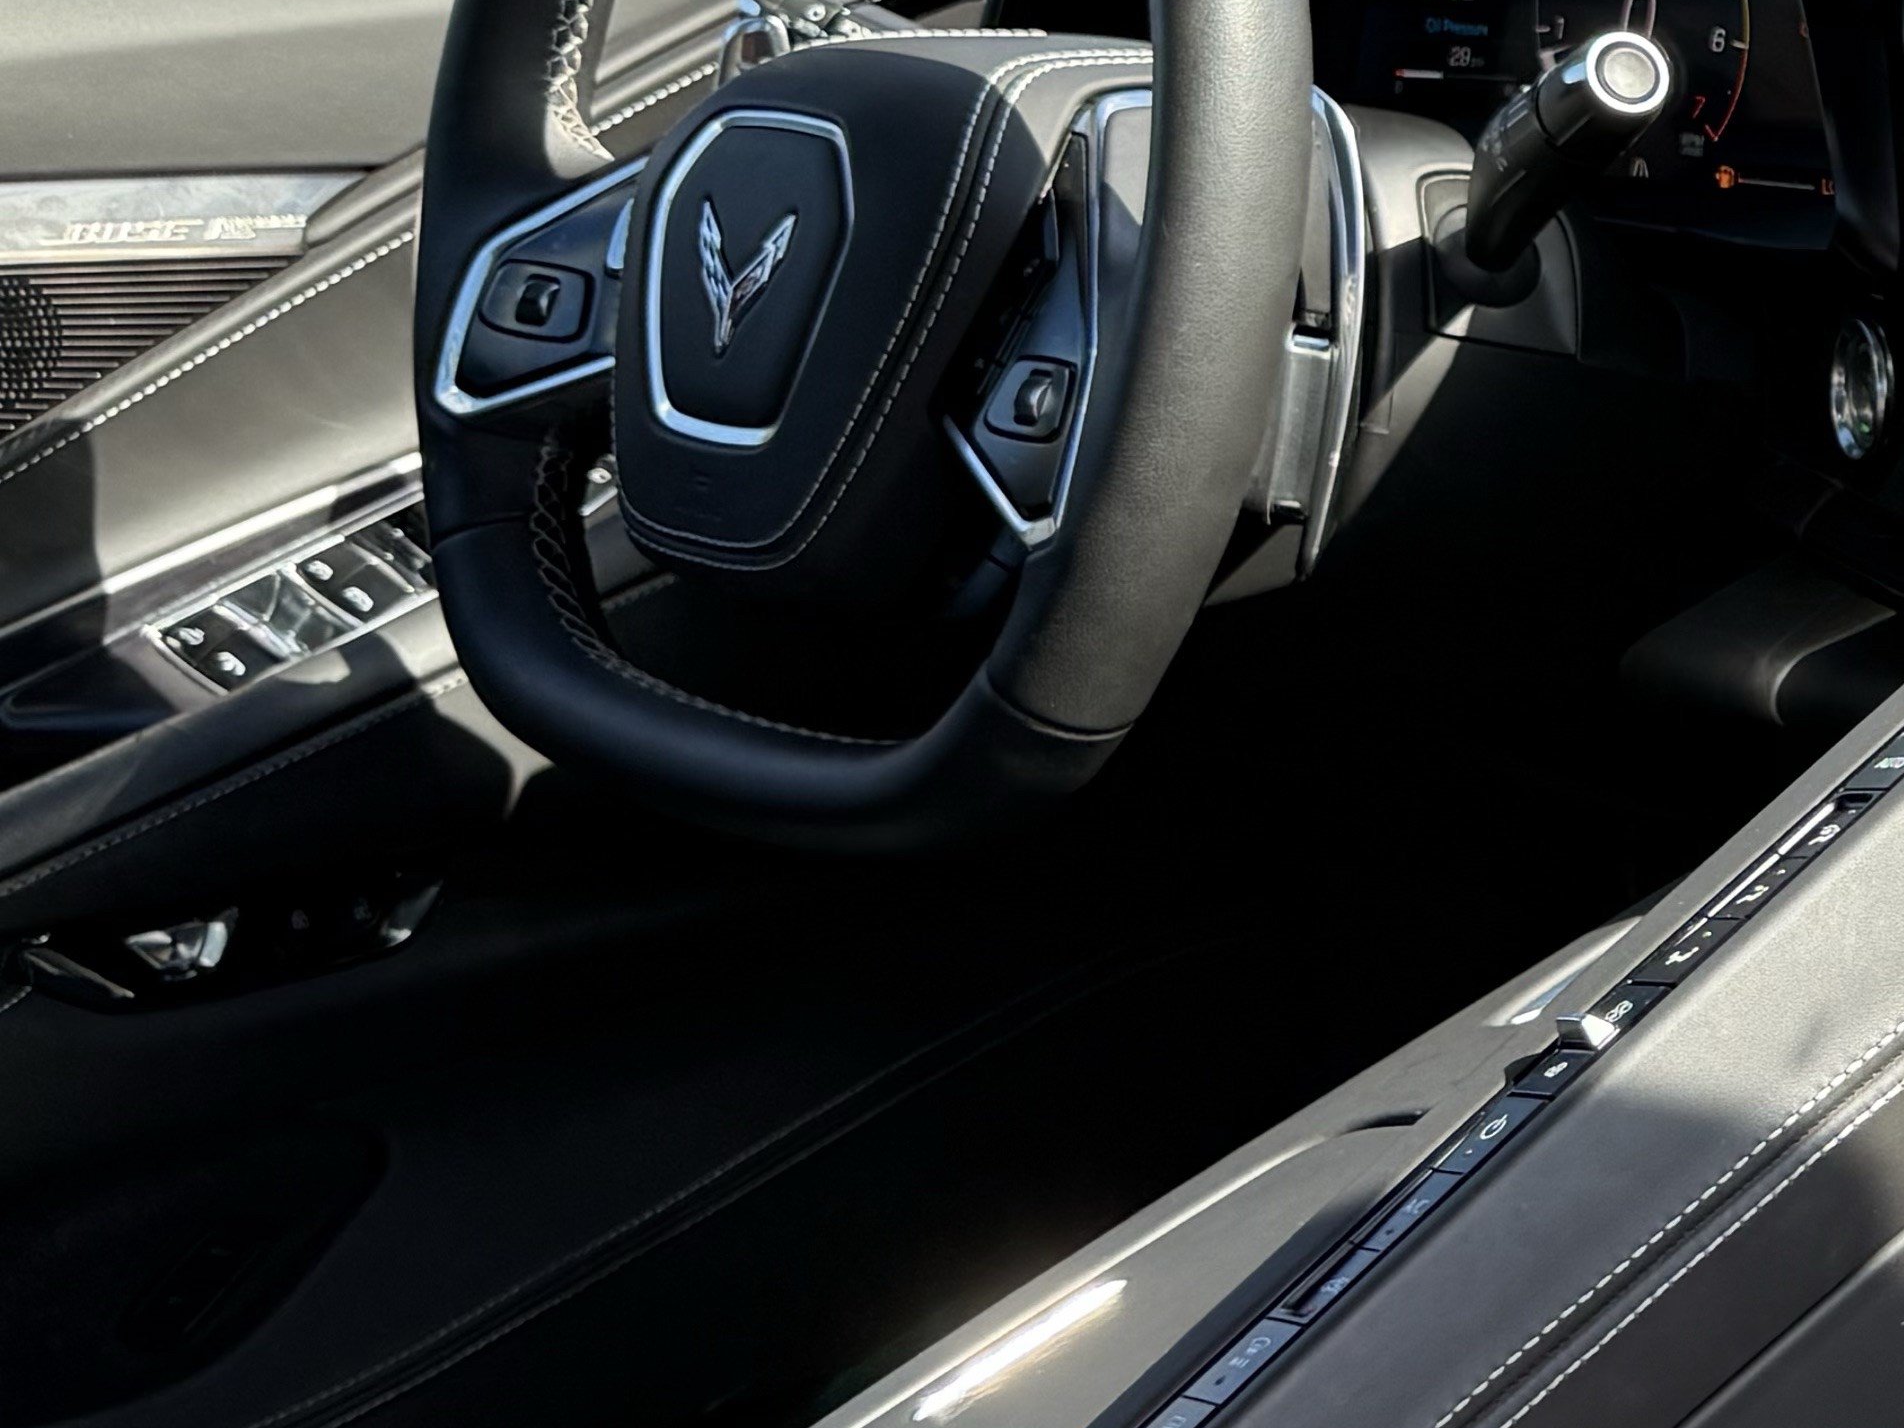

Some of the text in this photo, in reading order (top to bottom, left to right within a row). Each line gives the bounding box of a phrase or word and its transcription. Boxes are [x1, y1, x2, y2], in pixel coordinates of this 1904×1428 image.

[1552, 16, 1565, 41] 1
[1709, 26, 1727, 53] 6
[1690, 93, 1707, 120] 7
